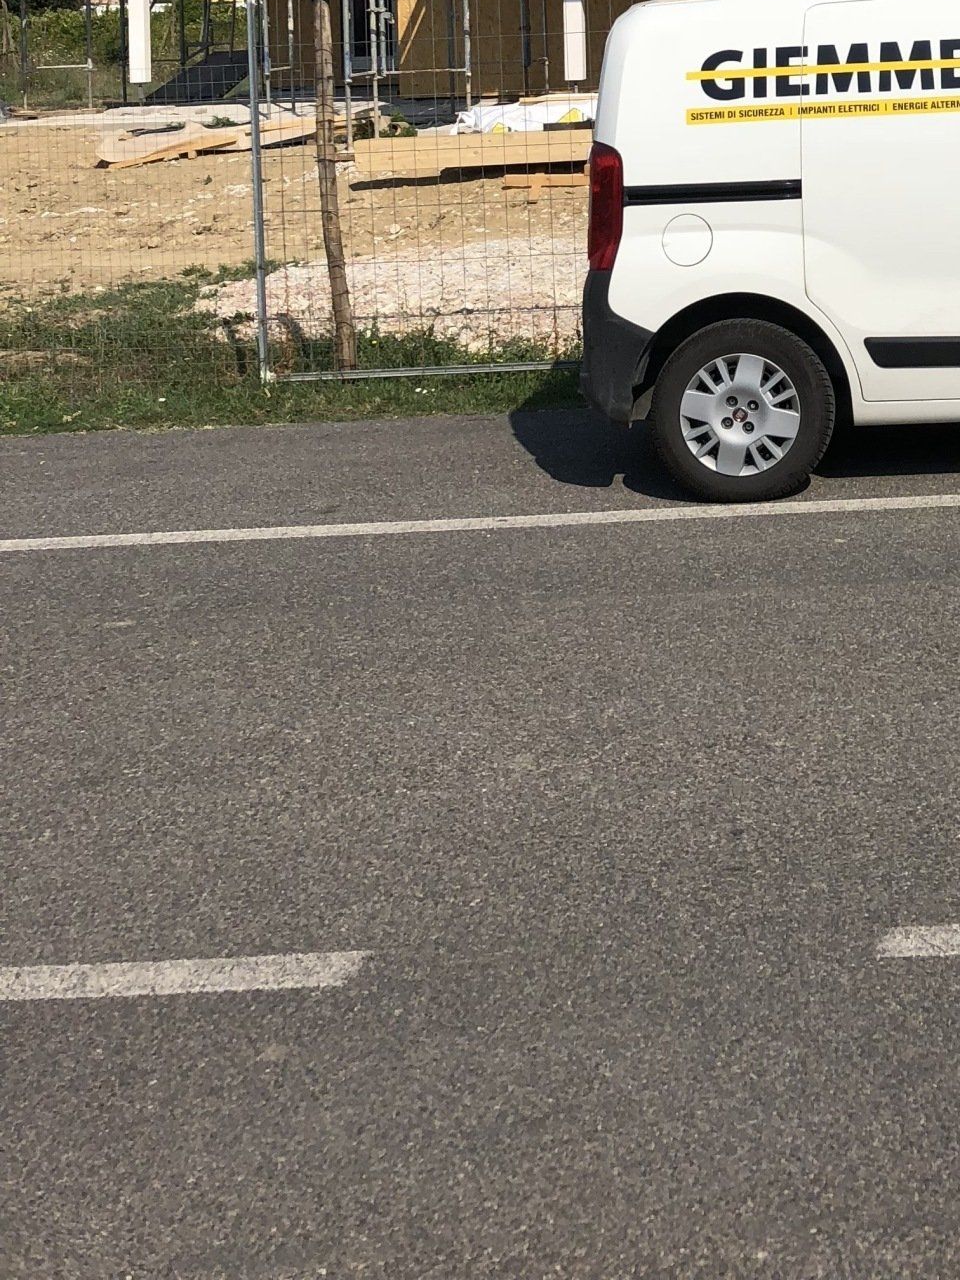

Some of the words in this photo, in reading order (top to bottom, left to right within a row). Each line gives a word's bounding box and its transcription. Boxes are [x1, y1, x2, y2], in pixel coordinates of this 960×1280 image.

[690, 111, 725, 121] SISTEMI
[727, 111, 737, 119] DI
[738, 107, 785, 118] SICUREZZA
[797, 105, 836, 115] IMPIANTI
[838, 103, 880, 113] ELETTRICI
[892, 101, 929, 111] ENERGIE
